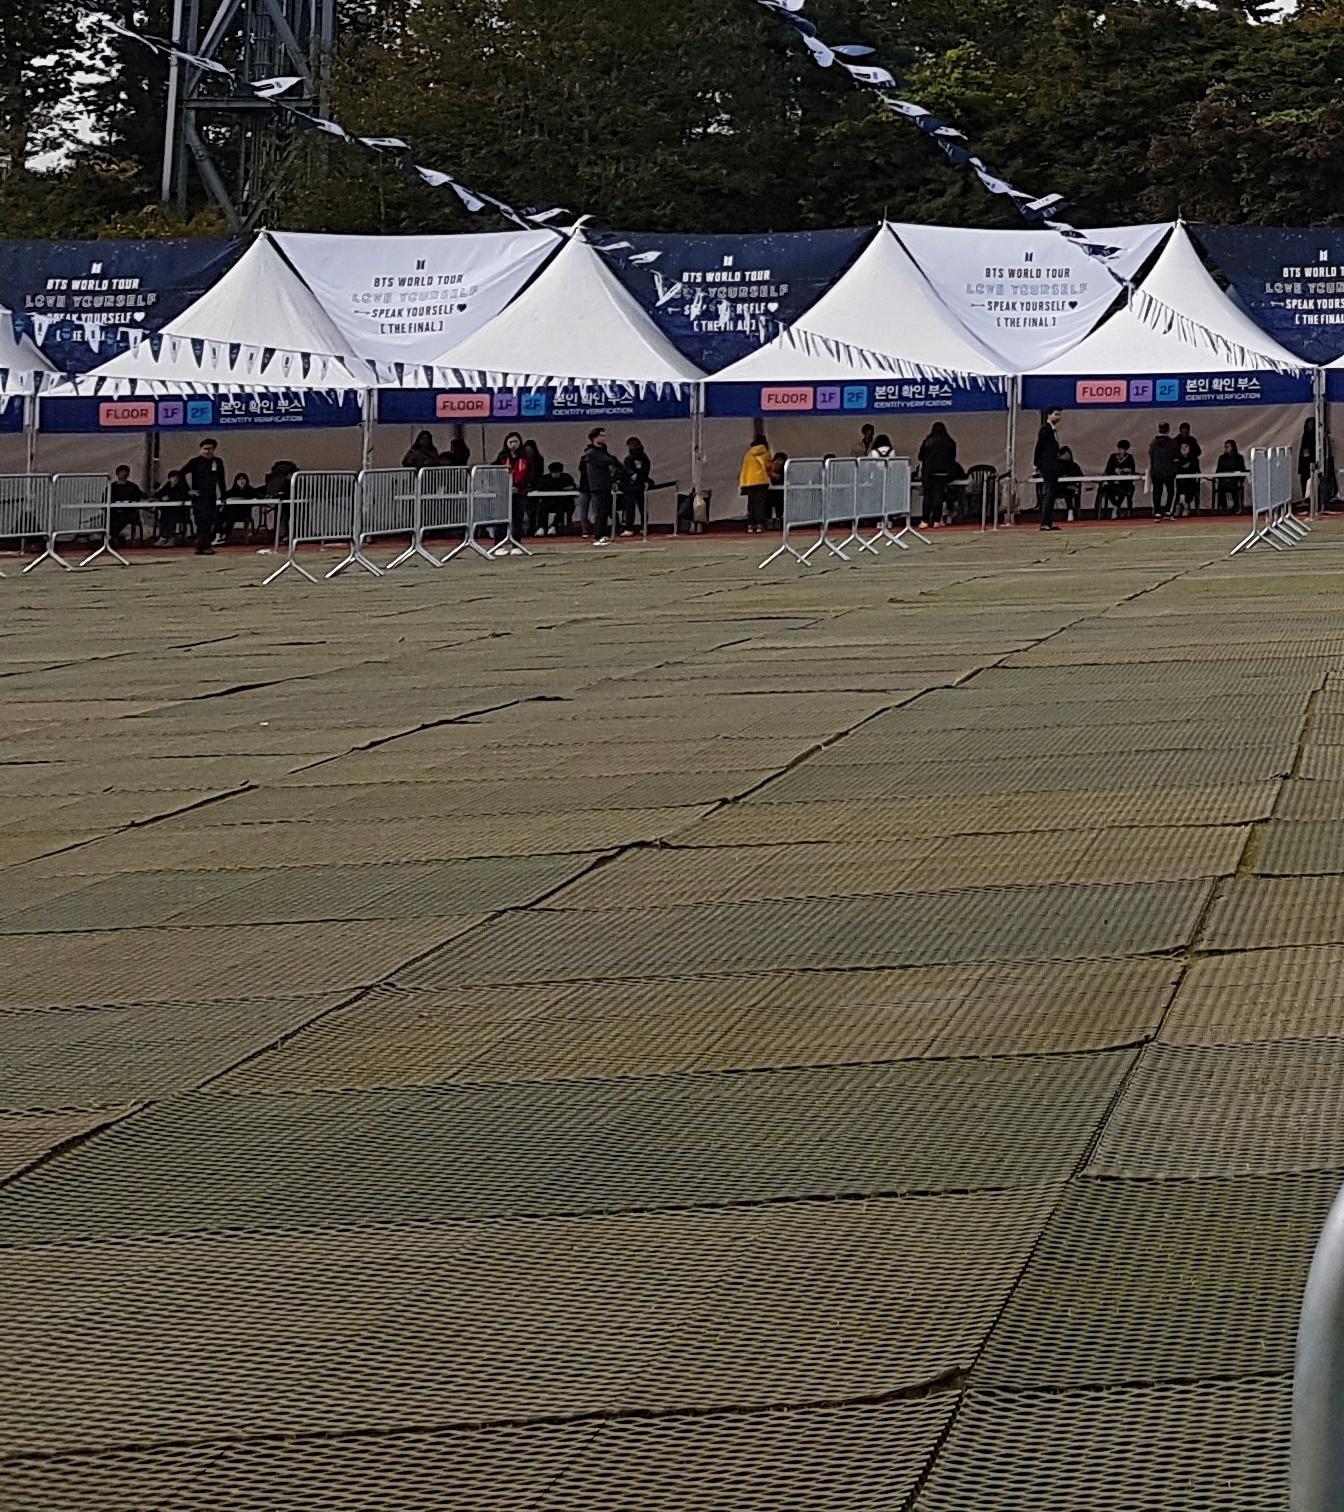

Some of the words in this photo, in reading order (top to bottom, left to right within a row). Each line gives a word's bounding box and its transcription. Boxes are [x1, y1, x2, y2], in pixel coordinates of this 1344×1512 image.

[985, 268, 1004, 278] BTS
[1008, 268, 1042, 279] WORLD
[1046, 268, 1070, 278] TOUR
[1283, 267, 1300, 278] BTS
[1304, 266, 1337, 277] WORLD
[47, 279, 68, 290] BTS
[71, 279, 108, 290] WORLD
[112, 278, 140, 290] TOUR
[374, 277, 393, 287] BTS
[398, 276, 433, 287] WORLD
[438, 274, 463, 285] TOUR
[352, 292, 392, 303] LOVE
[400, 285, 479, 303] YOURSELF
[966, 283, 1005, 295] LOVE
[1011, 283, 1088, 295] YOURSELF
[1265, 282, 1301, 294] LOVE
[987, 301, 1017, 311] SPEAK
[1020, 301, 1066, 311] YOURSELF
[1286, 299, 1314, 309] SPEAK
[371, 308, 403, 318] SPEAK
[407, 304, 454, 317] YOURSELF
[1082, 387, 1121, 397] FLOOR
[1133, 386, 1148, 396] 1F
[1160, 385, 1174, 395] 2F
[1186, 379, 1209, 393] 본인
[1212, 378, 1235, 392] 확인
[1237, 378, 1261, 390] 부스
[767, 393, 808, 404] FLOOR
[820, 393, 836, 403] 1F
[847, 392, 862, 403] 2F
[875, 386, 899, 400] 본인
[901, 385, 925, 399] 확인
[928, 386, 952, 398] 부스
[441, 400, 484, 411] FLOOR
[497, 399, 513, 410] 1F
[525, 399, 541, 410] 2F
[106, 408, 148, 420] FLOOR
[163, 408, 178, 419] 1F
[191, 407, 207, 419] 2F
